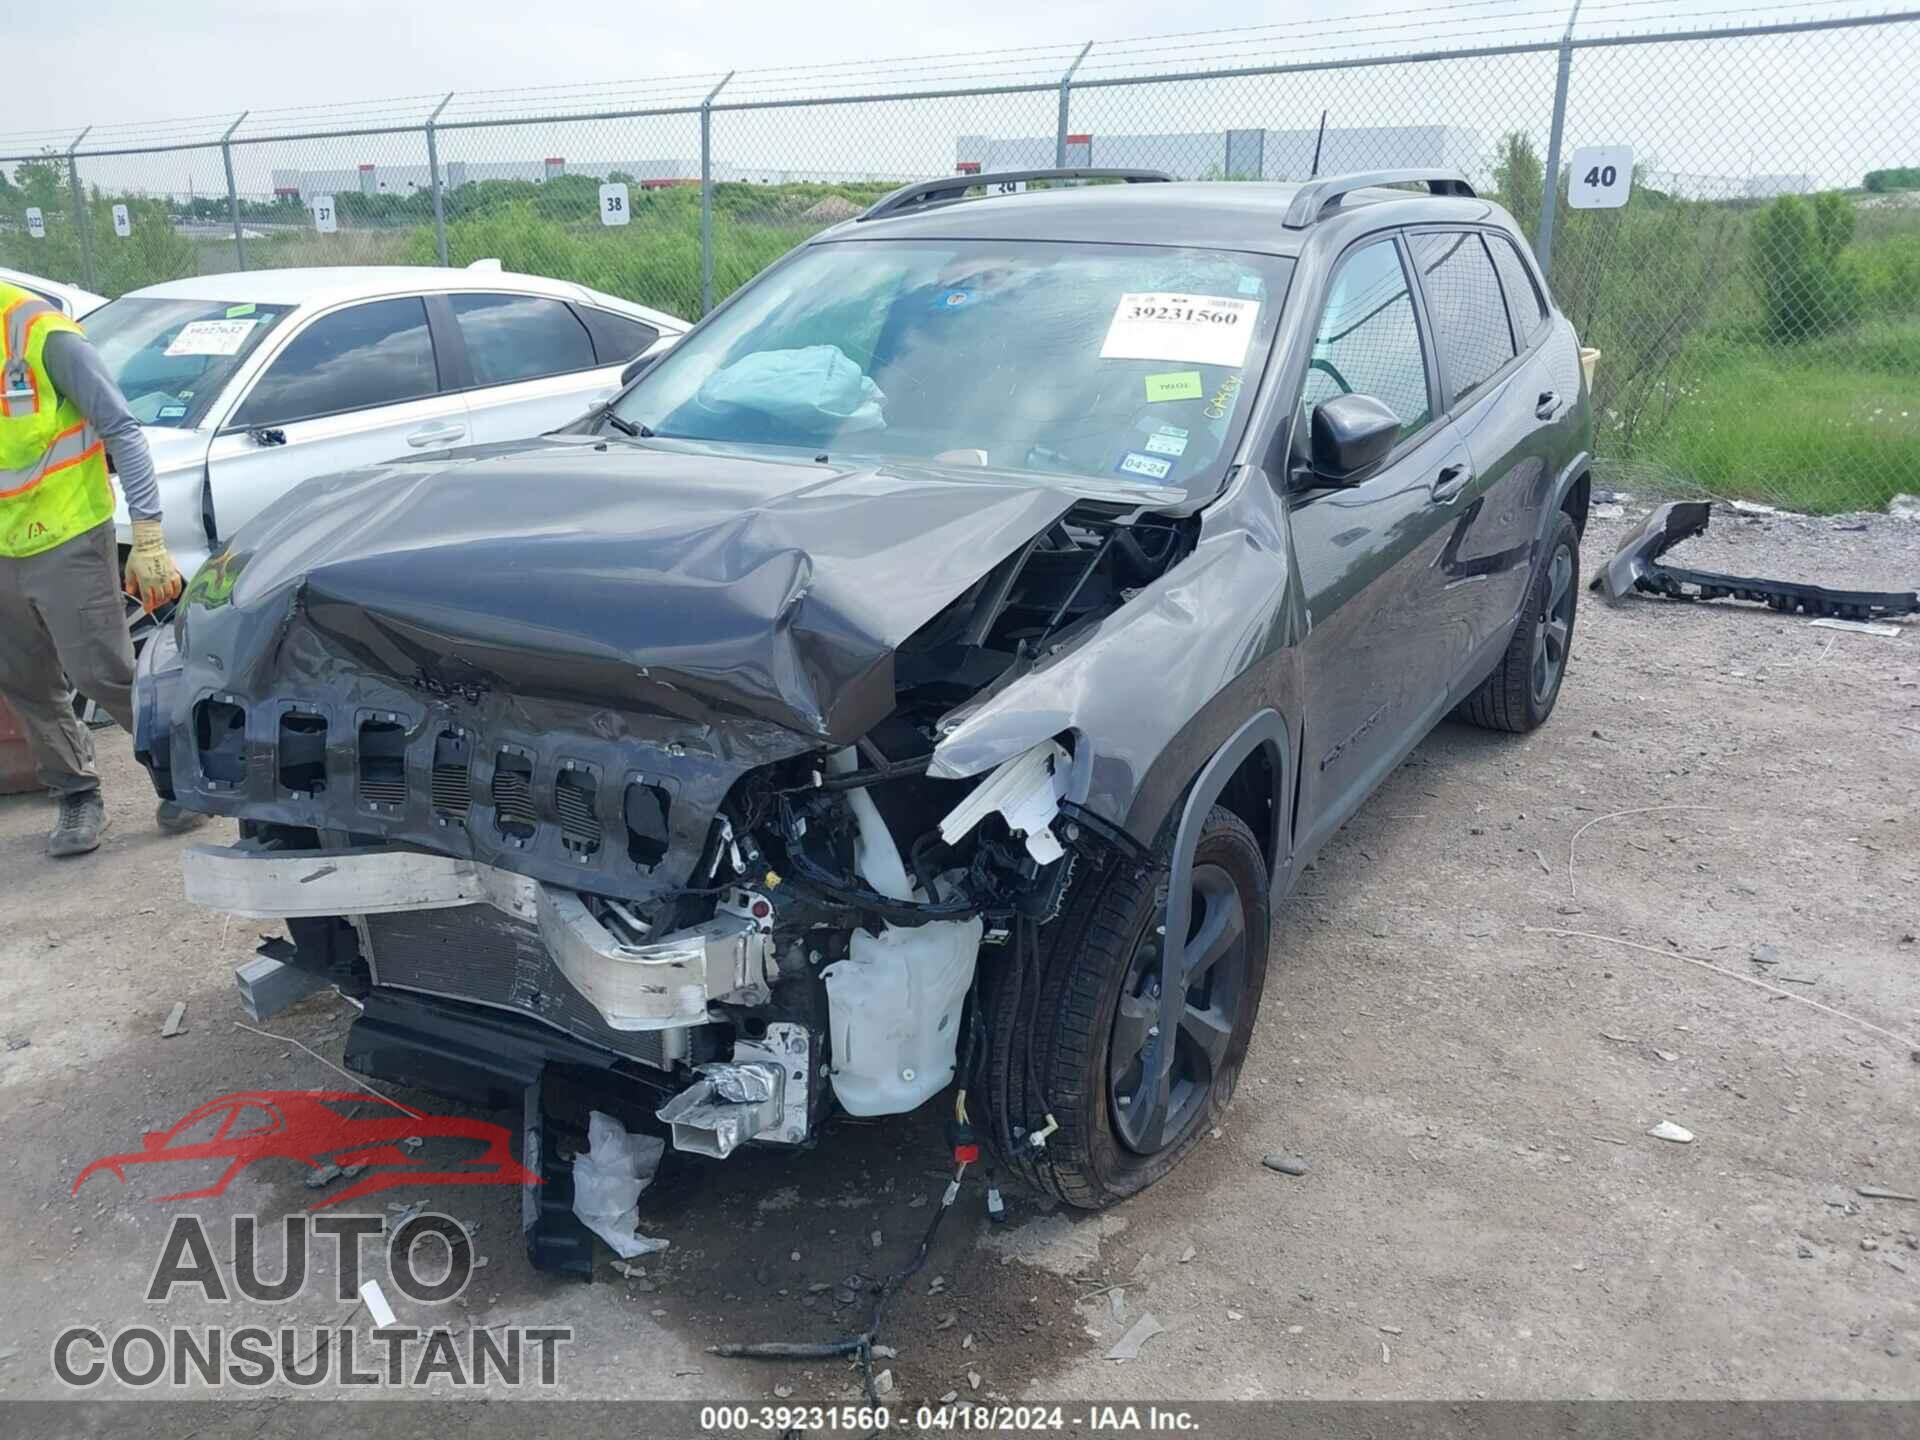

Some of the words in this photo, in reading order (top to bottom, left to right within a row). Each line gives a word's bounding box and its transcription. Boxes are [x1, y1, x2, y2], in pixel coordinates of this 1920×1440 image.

[1584, 166, 1617, 187] 40
[606, 197, 622, 211] 38
[318, 208, 330, 220] 37
[1127, 307, 1238, 325] 39231560
